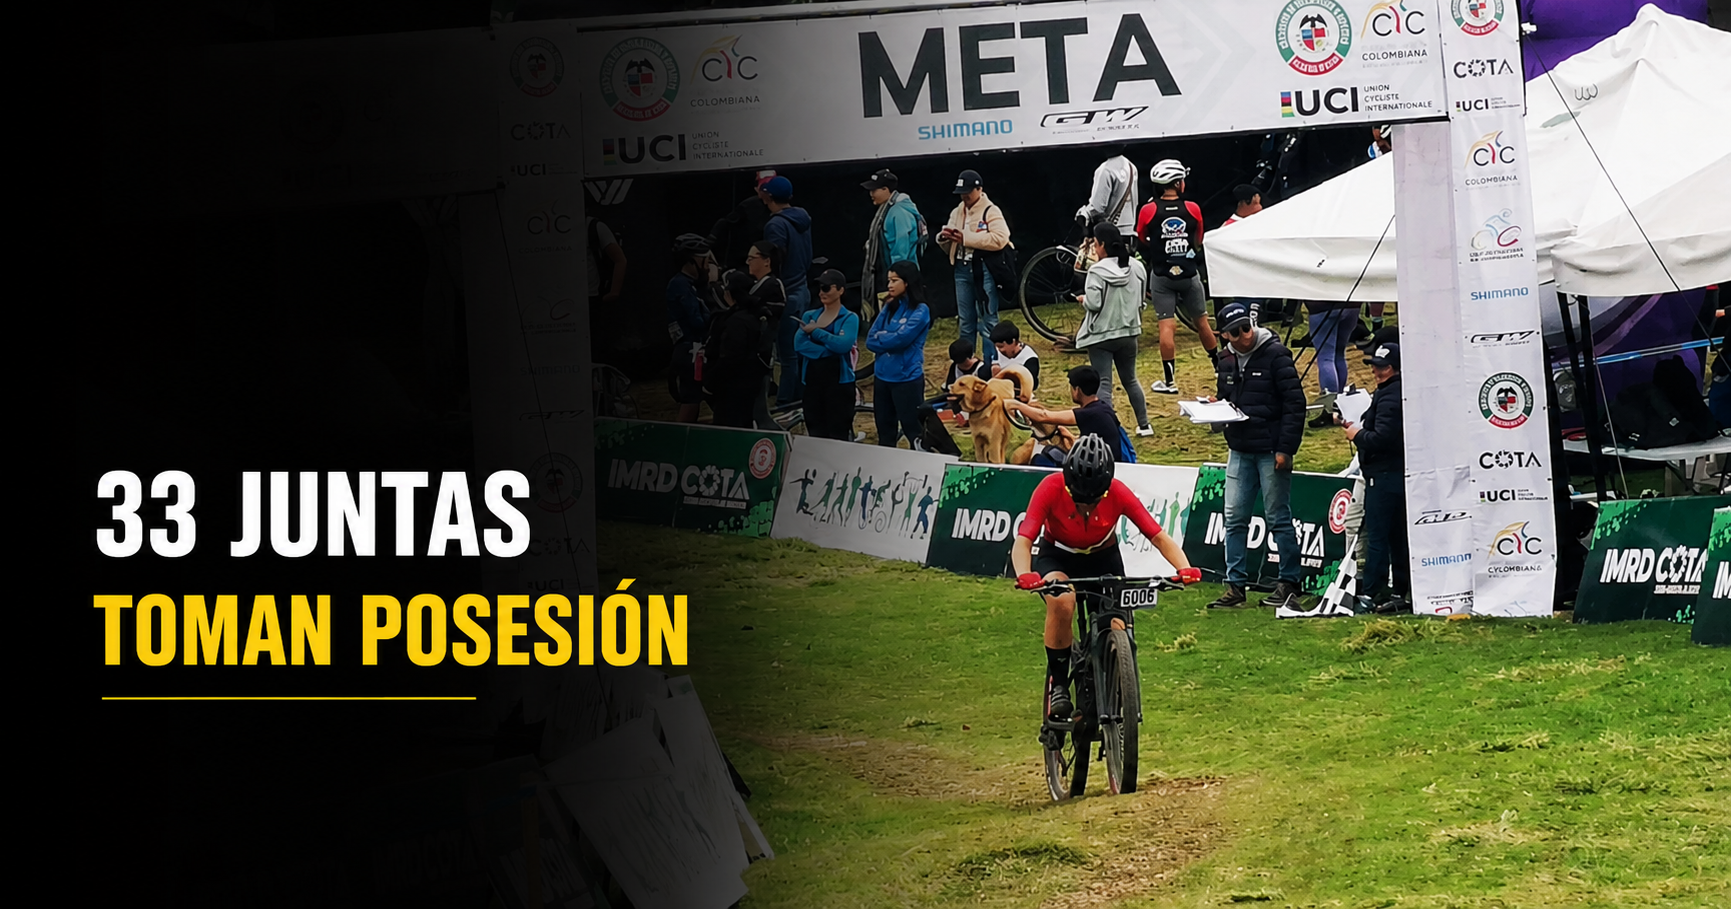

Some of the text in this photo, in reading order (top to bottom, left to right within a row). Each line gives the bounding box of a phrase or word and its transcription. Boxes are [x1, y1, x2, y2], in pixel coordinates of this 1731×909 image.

[1362, 49, 1428, 61] COLOMBIANA
[858, 13, 1182, 118] META
[1453, 58, 1514, 79] COTA
[1364, 84, 1390, 93] UNION
[690, 96, 760, 108] COLOMBIANA
[1295, 87, 1359, 116] UCI
[1364, 93, 1399, 103] CYCLISTE
[1462, 98, 1489, 112] UCI
[1365, 100, 1432, 112] INTERNATIONALE
[692, 131, 720, 140] UNION
[918, 119, 1013, 140] SHIMANO
[618, 134, 686, 164] UCI
[693, 149, 764, 160] INTERNATIONALE
[516, 164, 546, 177] UCI
[1465, 175, 1518, 186] COLOMBIANA
[1471, 287, 1529, 300] SHIMANO
[1479, 449, 1542, 469] COTA
[607, 458, 679, 493] IMRD
[681, 464, 750, 500] COTA
[1487, 489, 1516, 502] UCI
[951, 508, 1011, 542] IMRD
[1204, 512, 1266, 549] IMD
[1600, 544, 1708, 583] IMRD COTA
[1123, 588, 1155, 606] 6006
